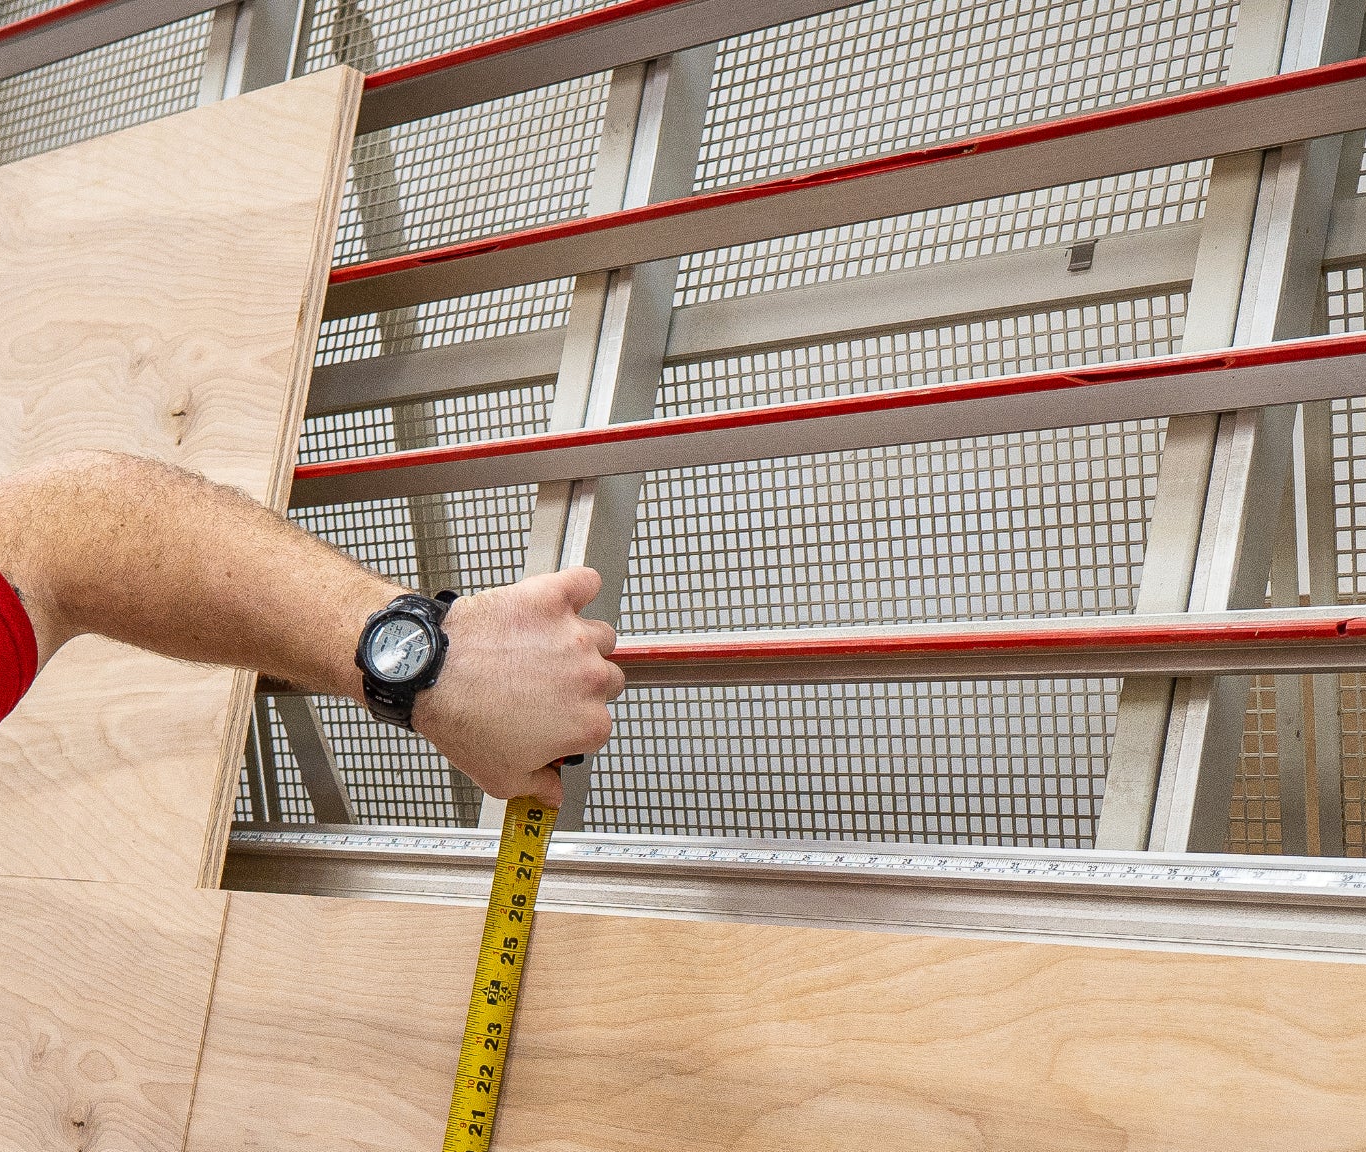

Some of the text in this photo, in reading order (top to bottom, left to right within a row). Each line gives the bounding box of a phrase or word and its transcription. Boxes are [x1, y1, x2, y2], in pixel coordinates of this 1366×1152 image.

[525, 808, 544, 839] 28
[516, 850, 535, 881] 27
[508, 893, 527, 923] 26
[500, 936, 519, 966] 25
[483, 1022, 502, 1052] 23
[476, 1064, 495, 1095] 22
[468, 1109, 486, 1138] 21
